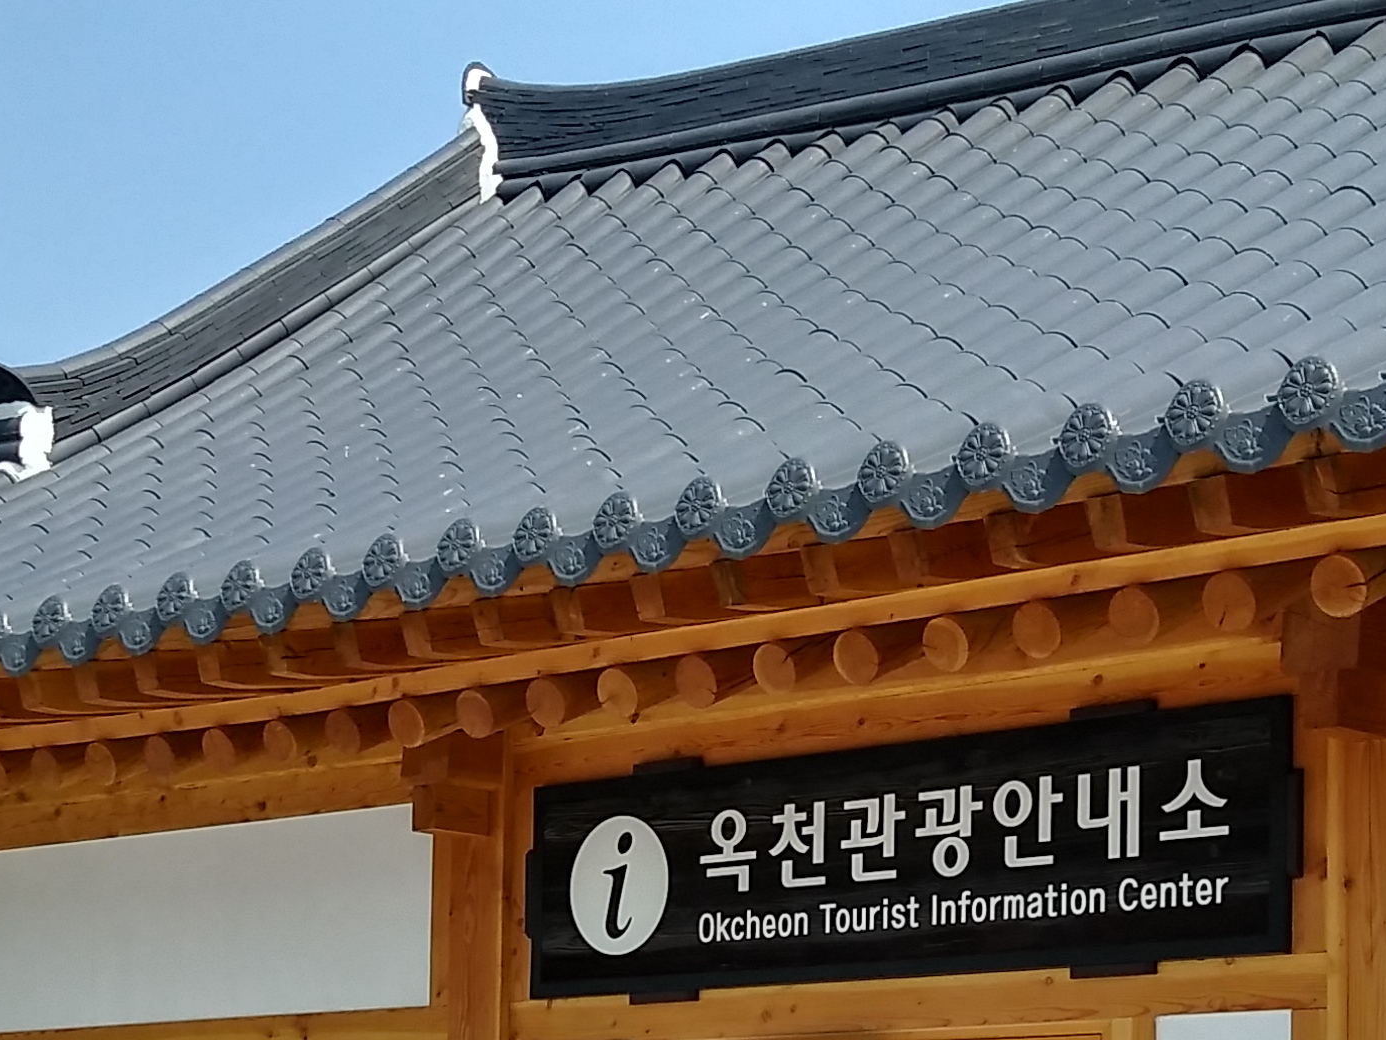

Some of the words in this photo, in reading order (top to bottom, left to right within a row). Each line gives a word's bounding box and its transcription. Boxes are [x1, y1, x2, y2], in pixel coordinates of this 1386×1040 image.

[699, 758, 1230, 892] 옥천관광안내소
[698, 909, 809, 943] Okcheon
[819, 896, 920, 934] Tourist
[931, 883, 1106, 926] Information
[1118, 872, 1229, 912] Center
